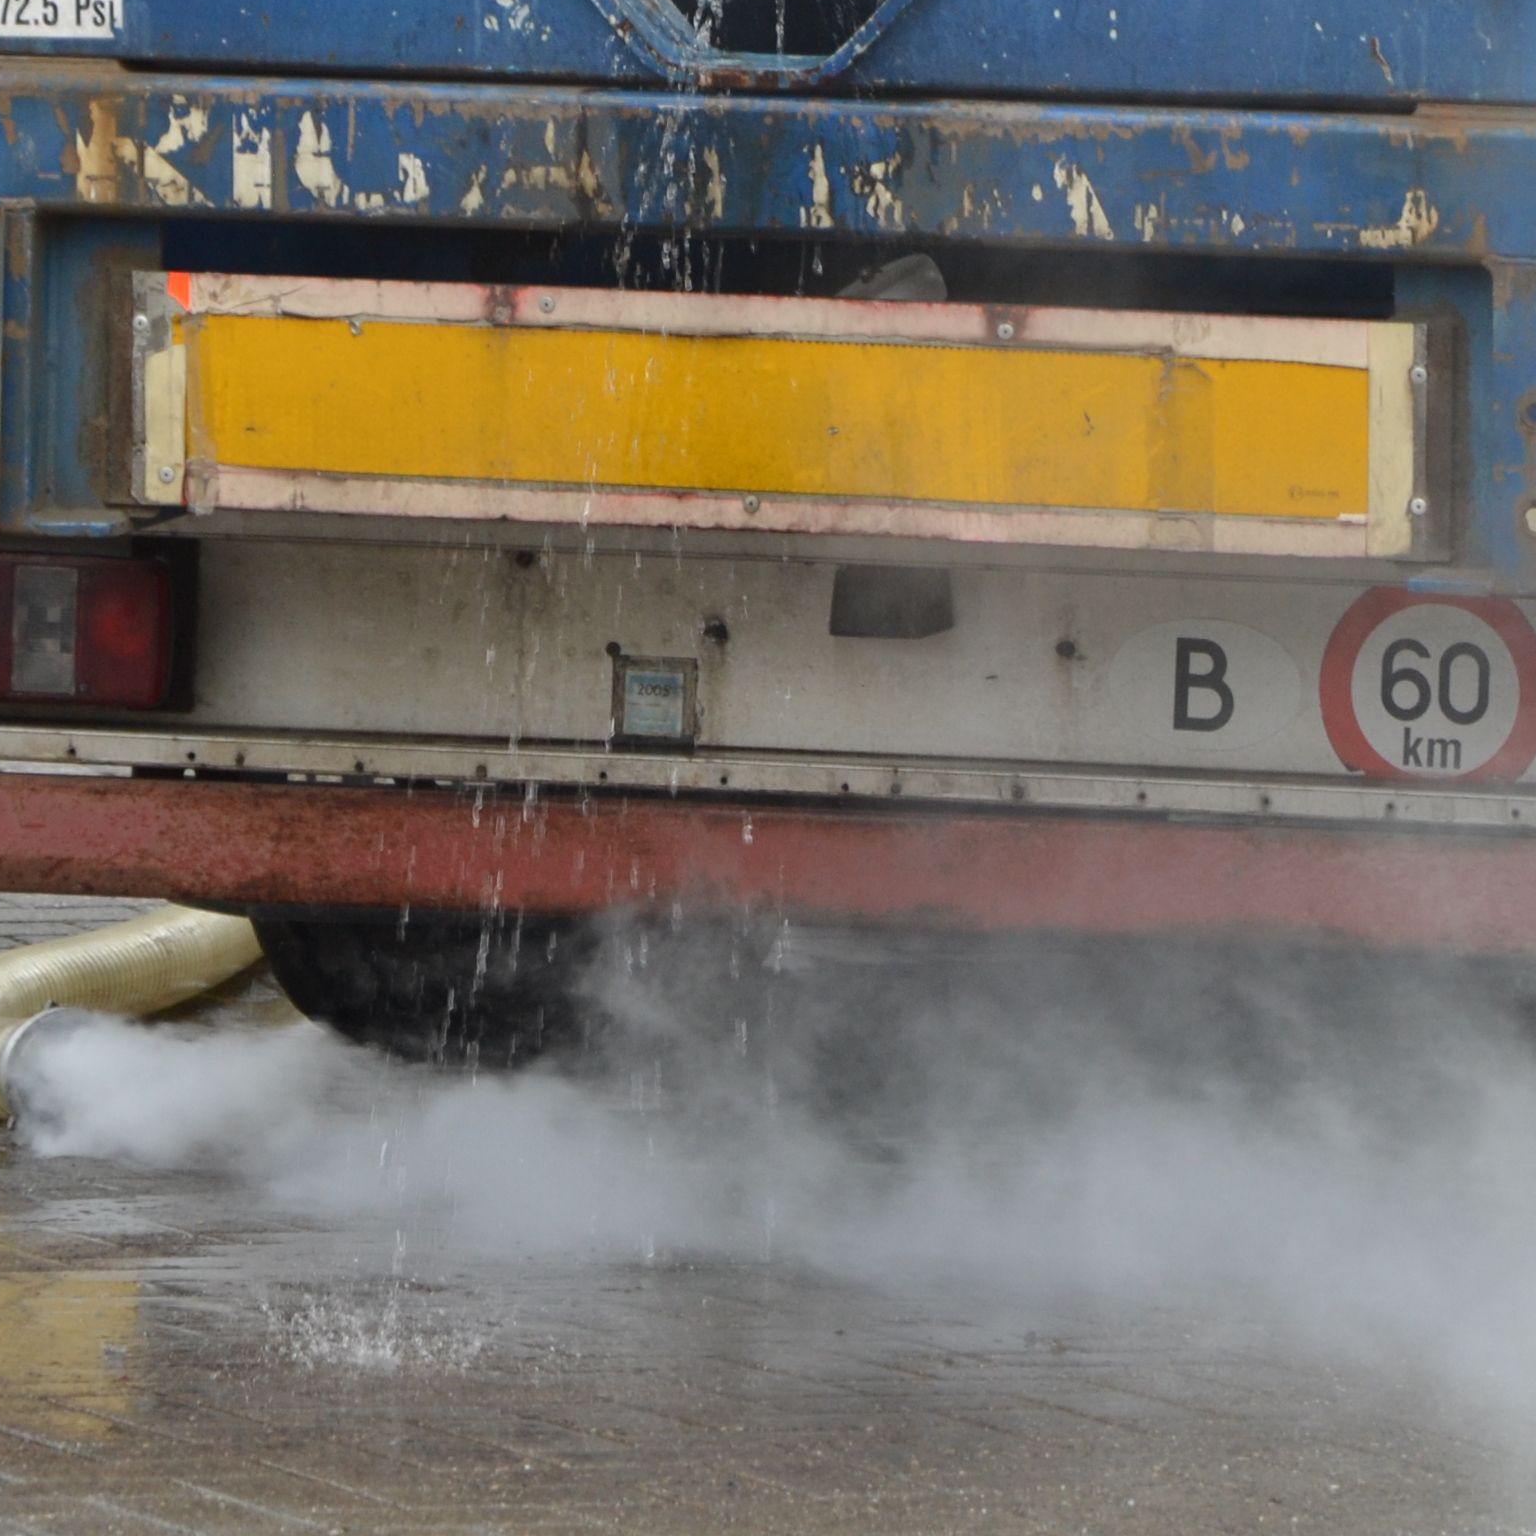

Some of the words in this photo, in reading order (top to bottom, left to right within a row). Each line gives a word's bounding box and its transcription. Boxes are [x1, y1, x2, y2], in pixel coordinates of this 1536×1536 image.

[1173, 637, 1234, 732] B
[1380, 638, 1490, 726] 60
[1402, 727, 1462, 770] km
